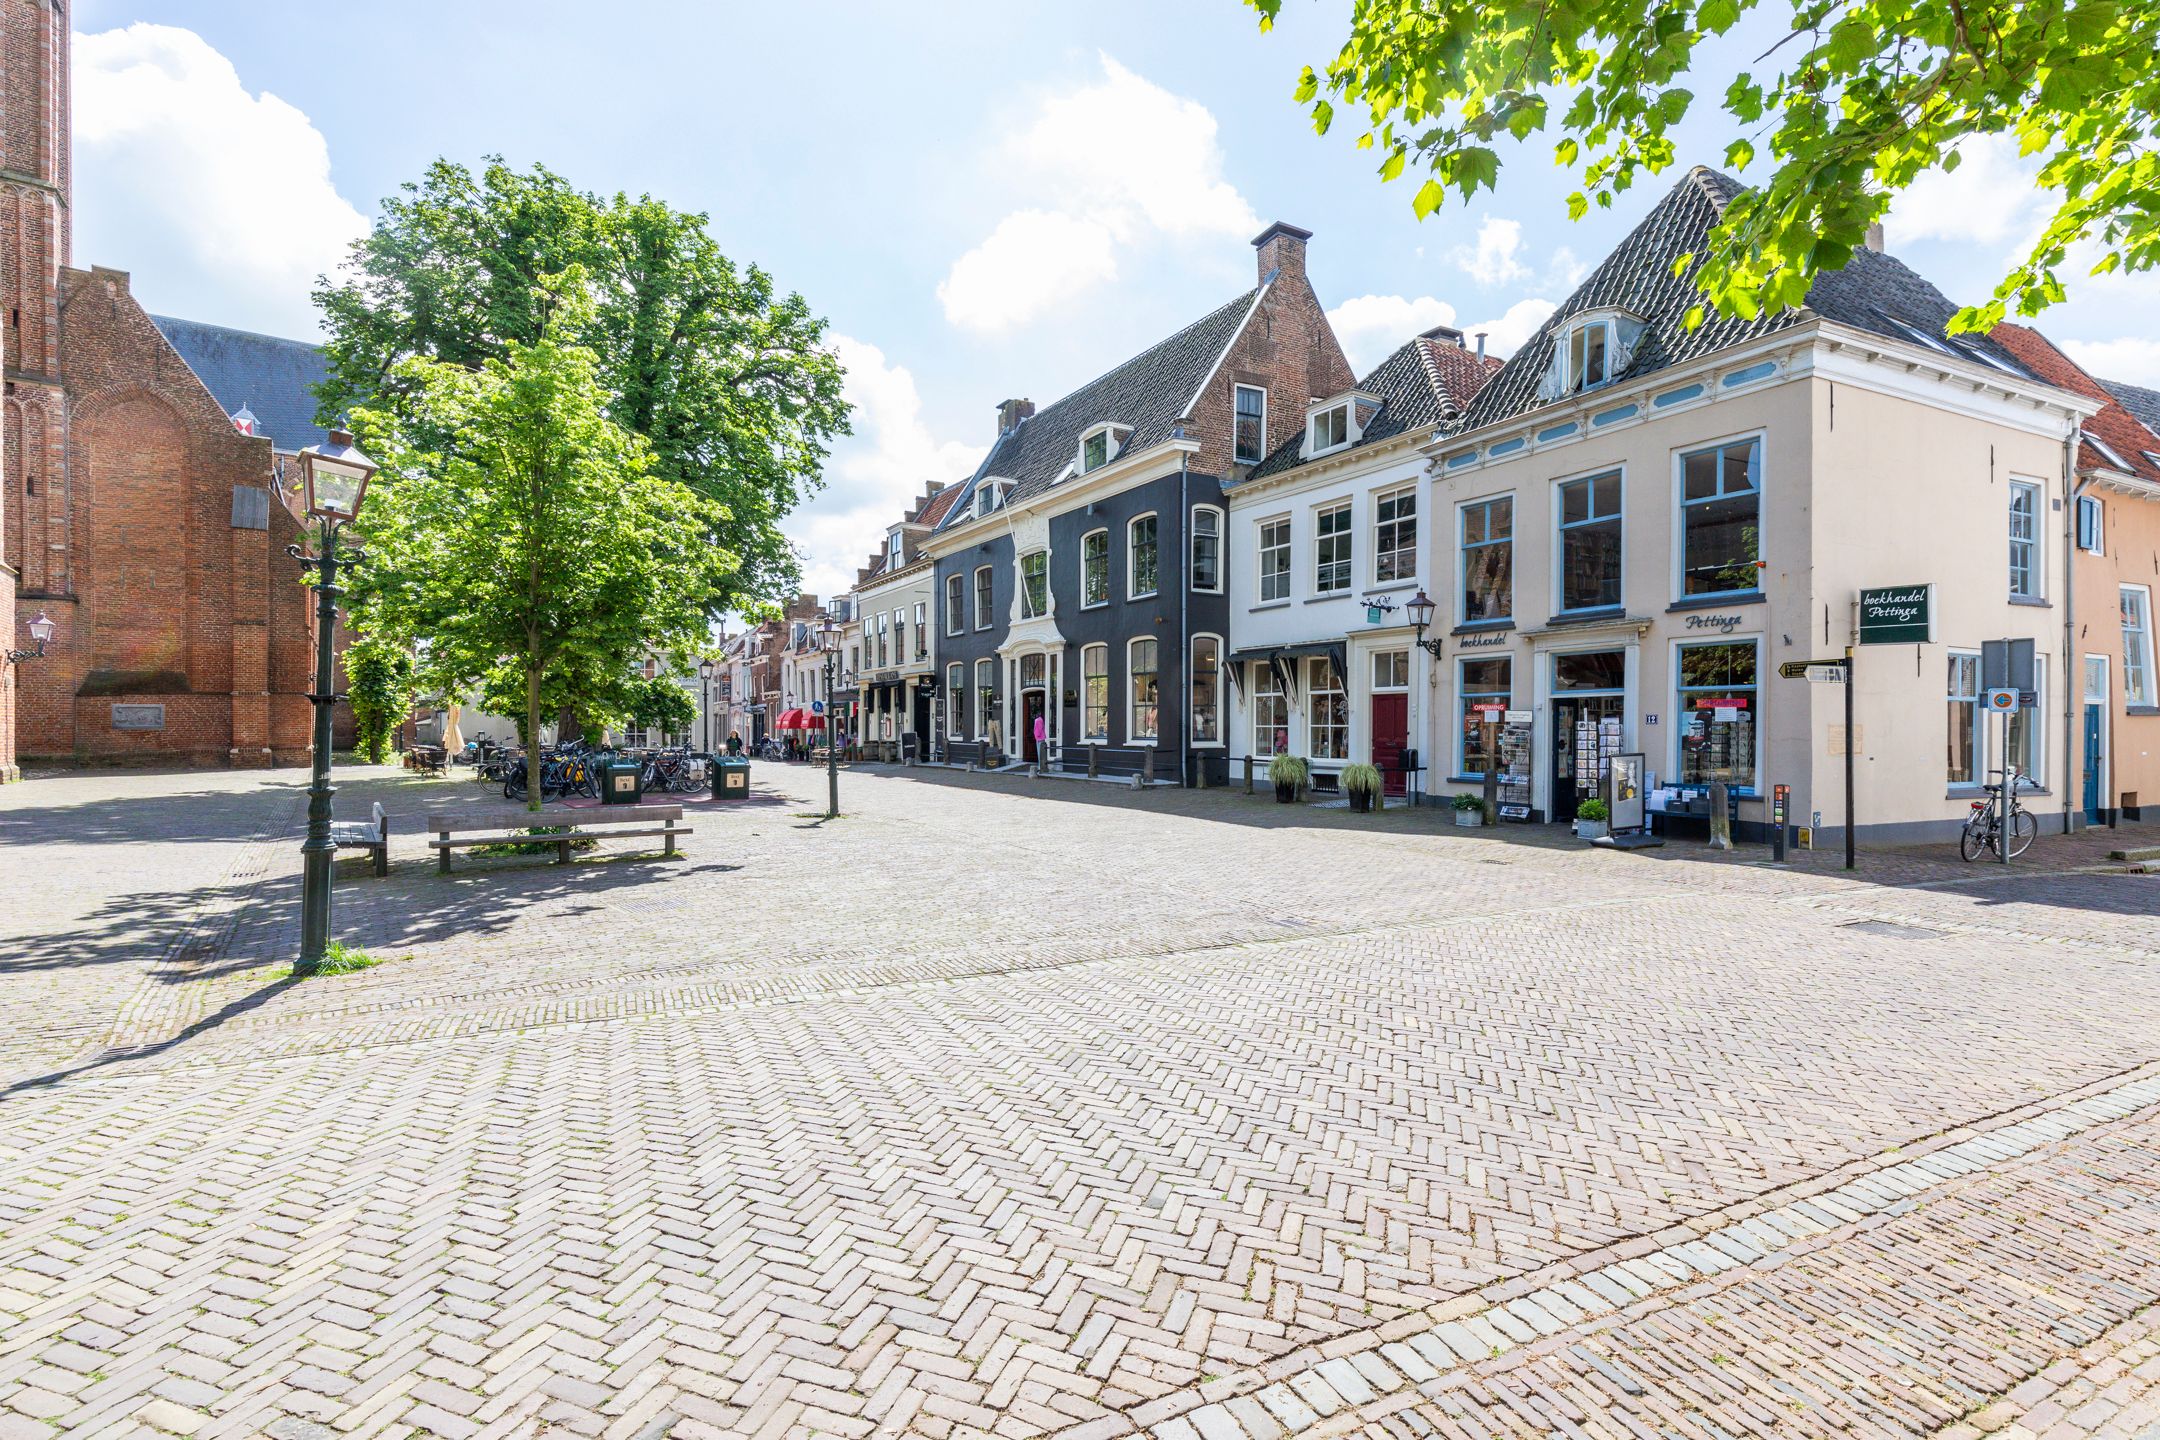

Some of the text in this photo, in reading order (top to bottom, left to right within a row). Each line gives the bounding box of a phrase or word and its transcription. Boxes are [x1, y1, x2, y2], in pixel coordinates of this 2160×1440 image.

[1863, 588, 1926, 605] boekhandel
[1868, 606, 1918, 621] Pettinga
[1685, 614, 1742, 633] Pettinga
[1460, 632, 1507, 648] boekhandel
[1647, 715, 1656, 723] 12
